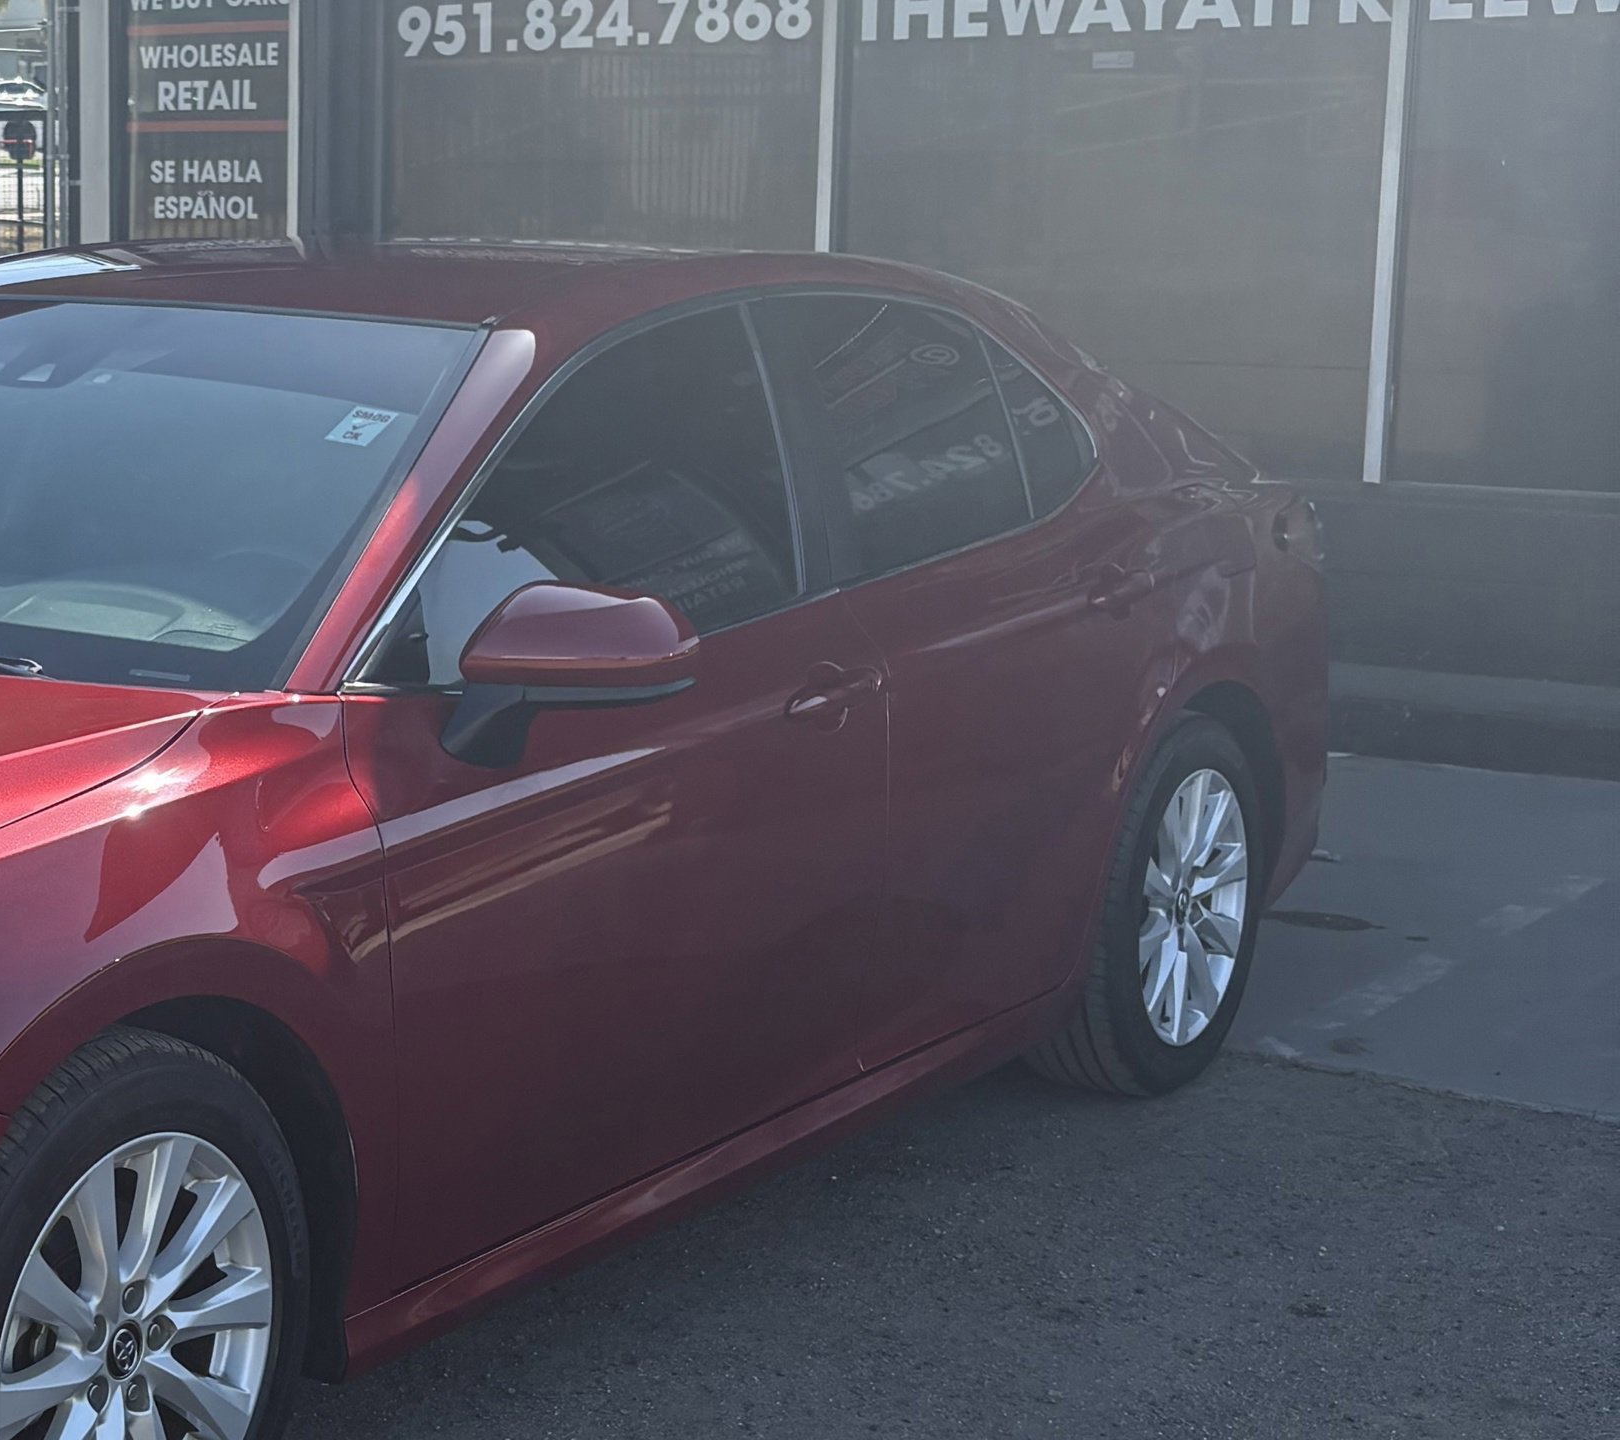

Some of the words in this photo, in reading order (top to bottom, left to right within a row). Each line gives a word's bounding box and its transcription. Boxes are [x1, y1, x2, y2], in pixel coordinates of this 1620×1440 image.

[139, 42, 279, 69] WHOLESALE
[158, 79, 257, 111] RETAIL
[150, 160, 177, 185] SE
[182, 159, 262, 185] HABLA
[154, 190, 258, 221] ESPAÑOL
[352, 409, 391, 423] SMOG
